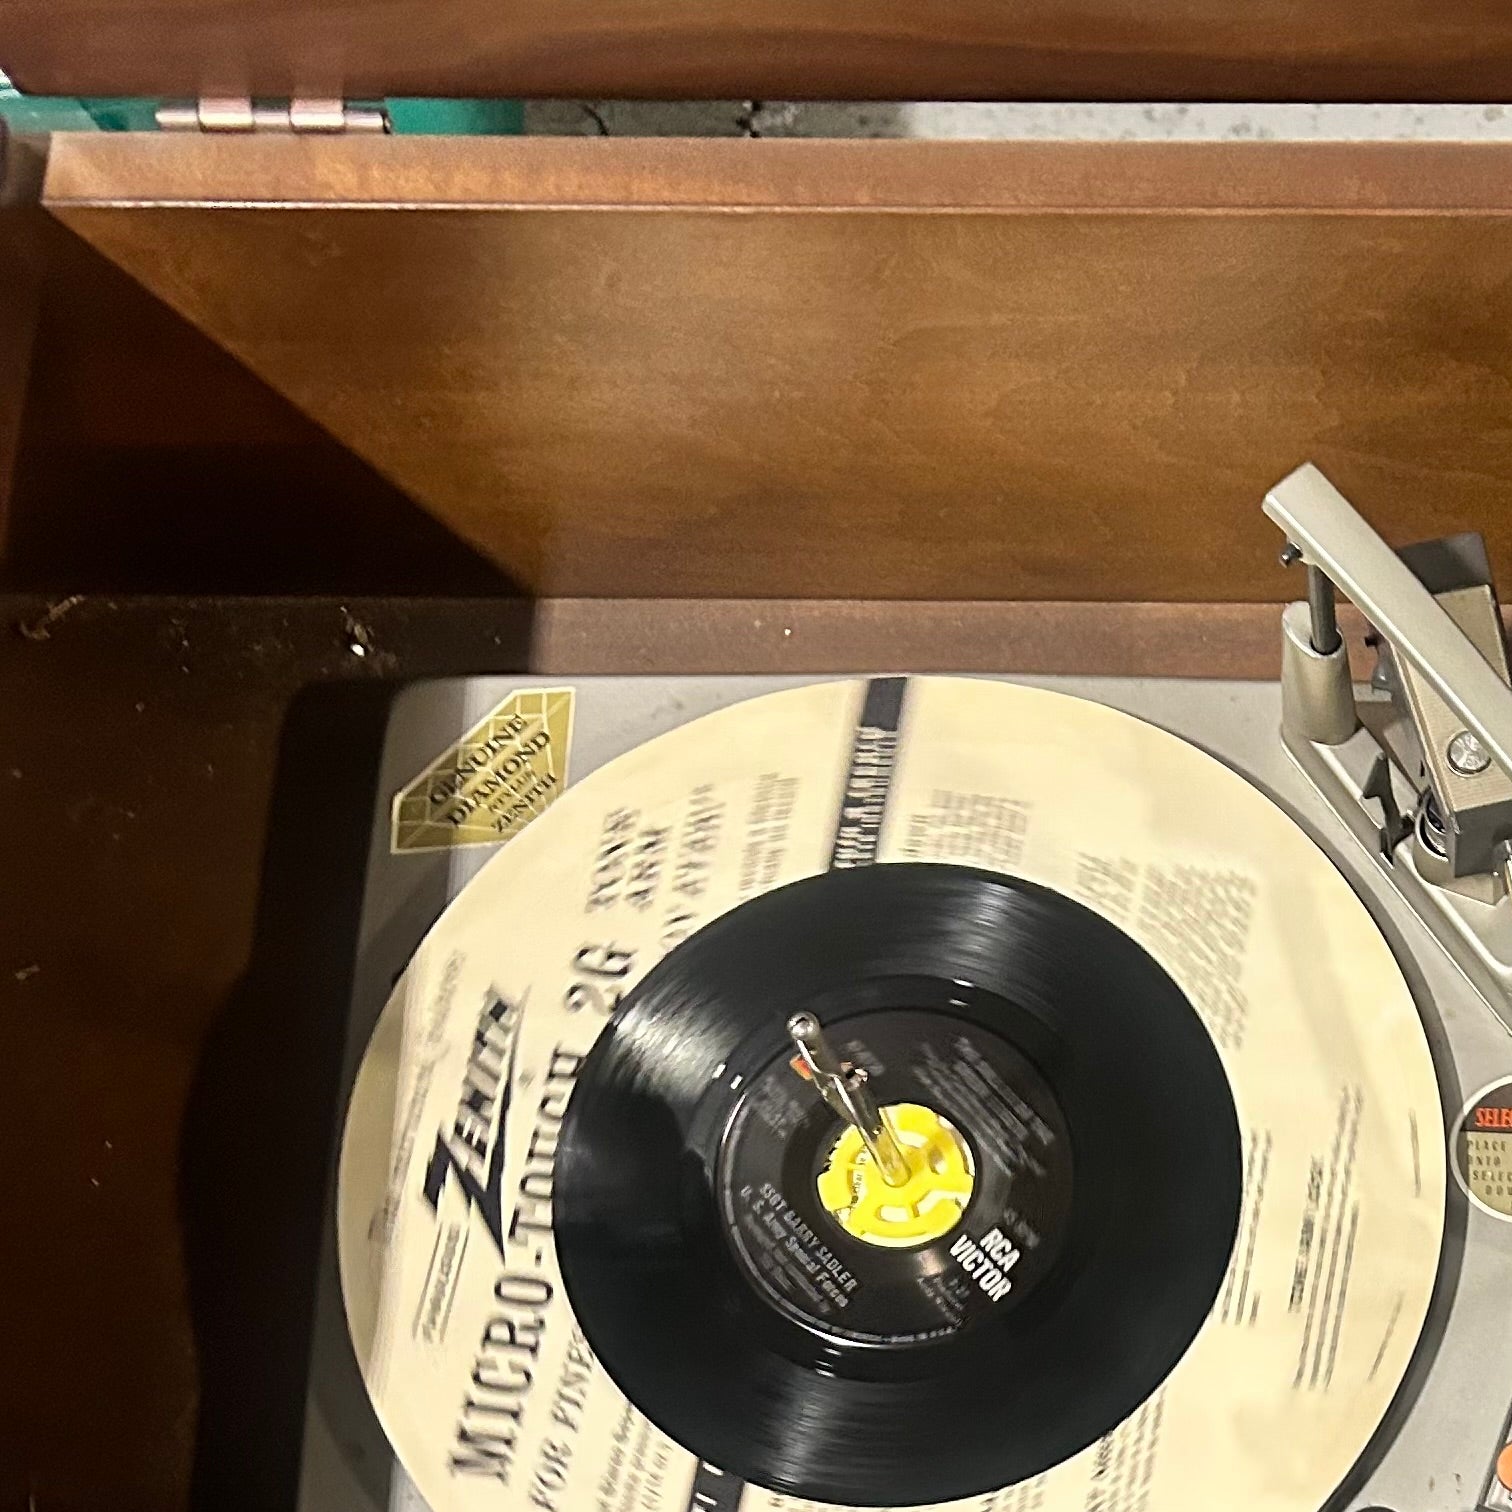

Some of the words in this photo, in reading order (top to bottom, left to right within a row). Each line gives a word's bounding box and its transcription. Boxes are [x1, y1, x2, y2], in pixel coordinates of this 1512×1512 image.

[429, 713, 527, 804] GENUINE
[446, 731, 550, 825] DIAMOND
[491, 772, 558, 832] ZENITH
[423, 983, 532, 1268] ZENITH
[815, 1243, 859, 1292] SADLER
[949, 1234, 1013, 1303] VICTOR
[980, 1227, 1021, 1273] RCA
